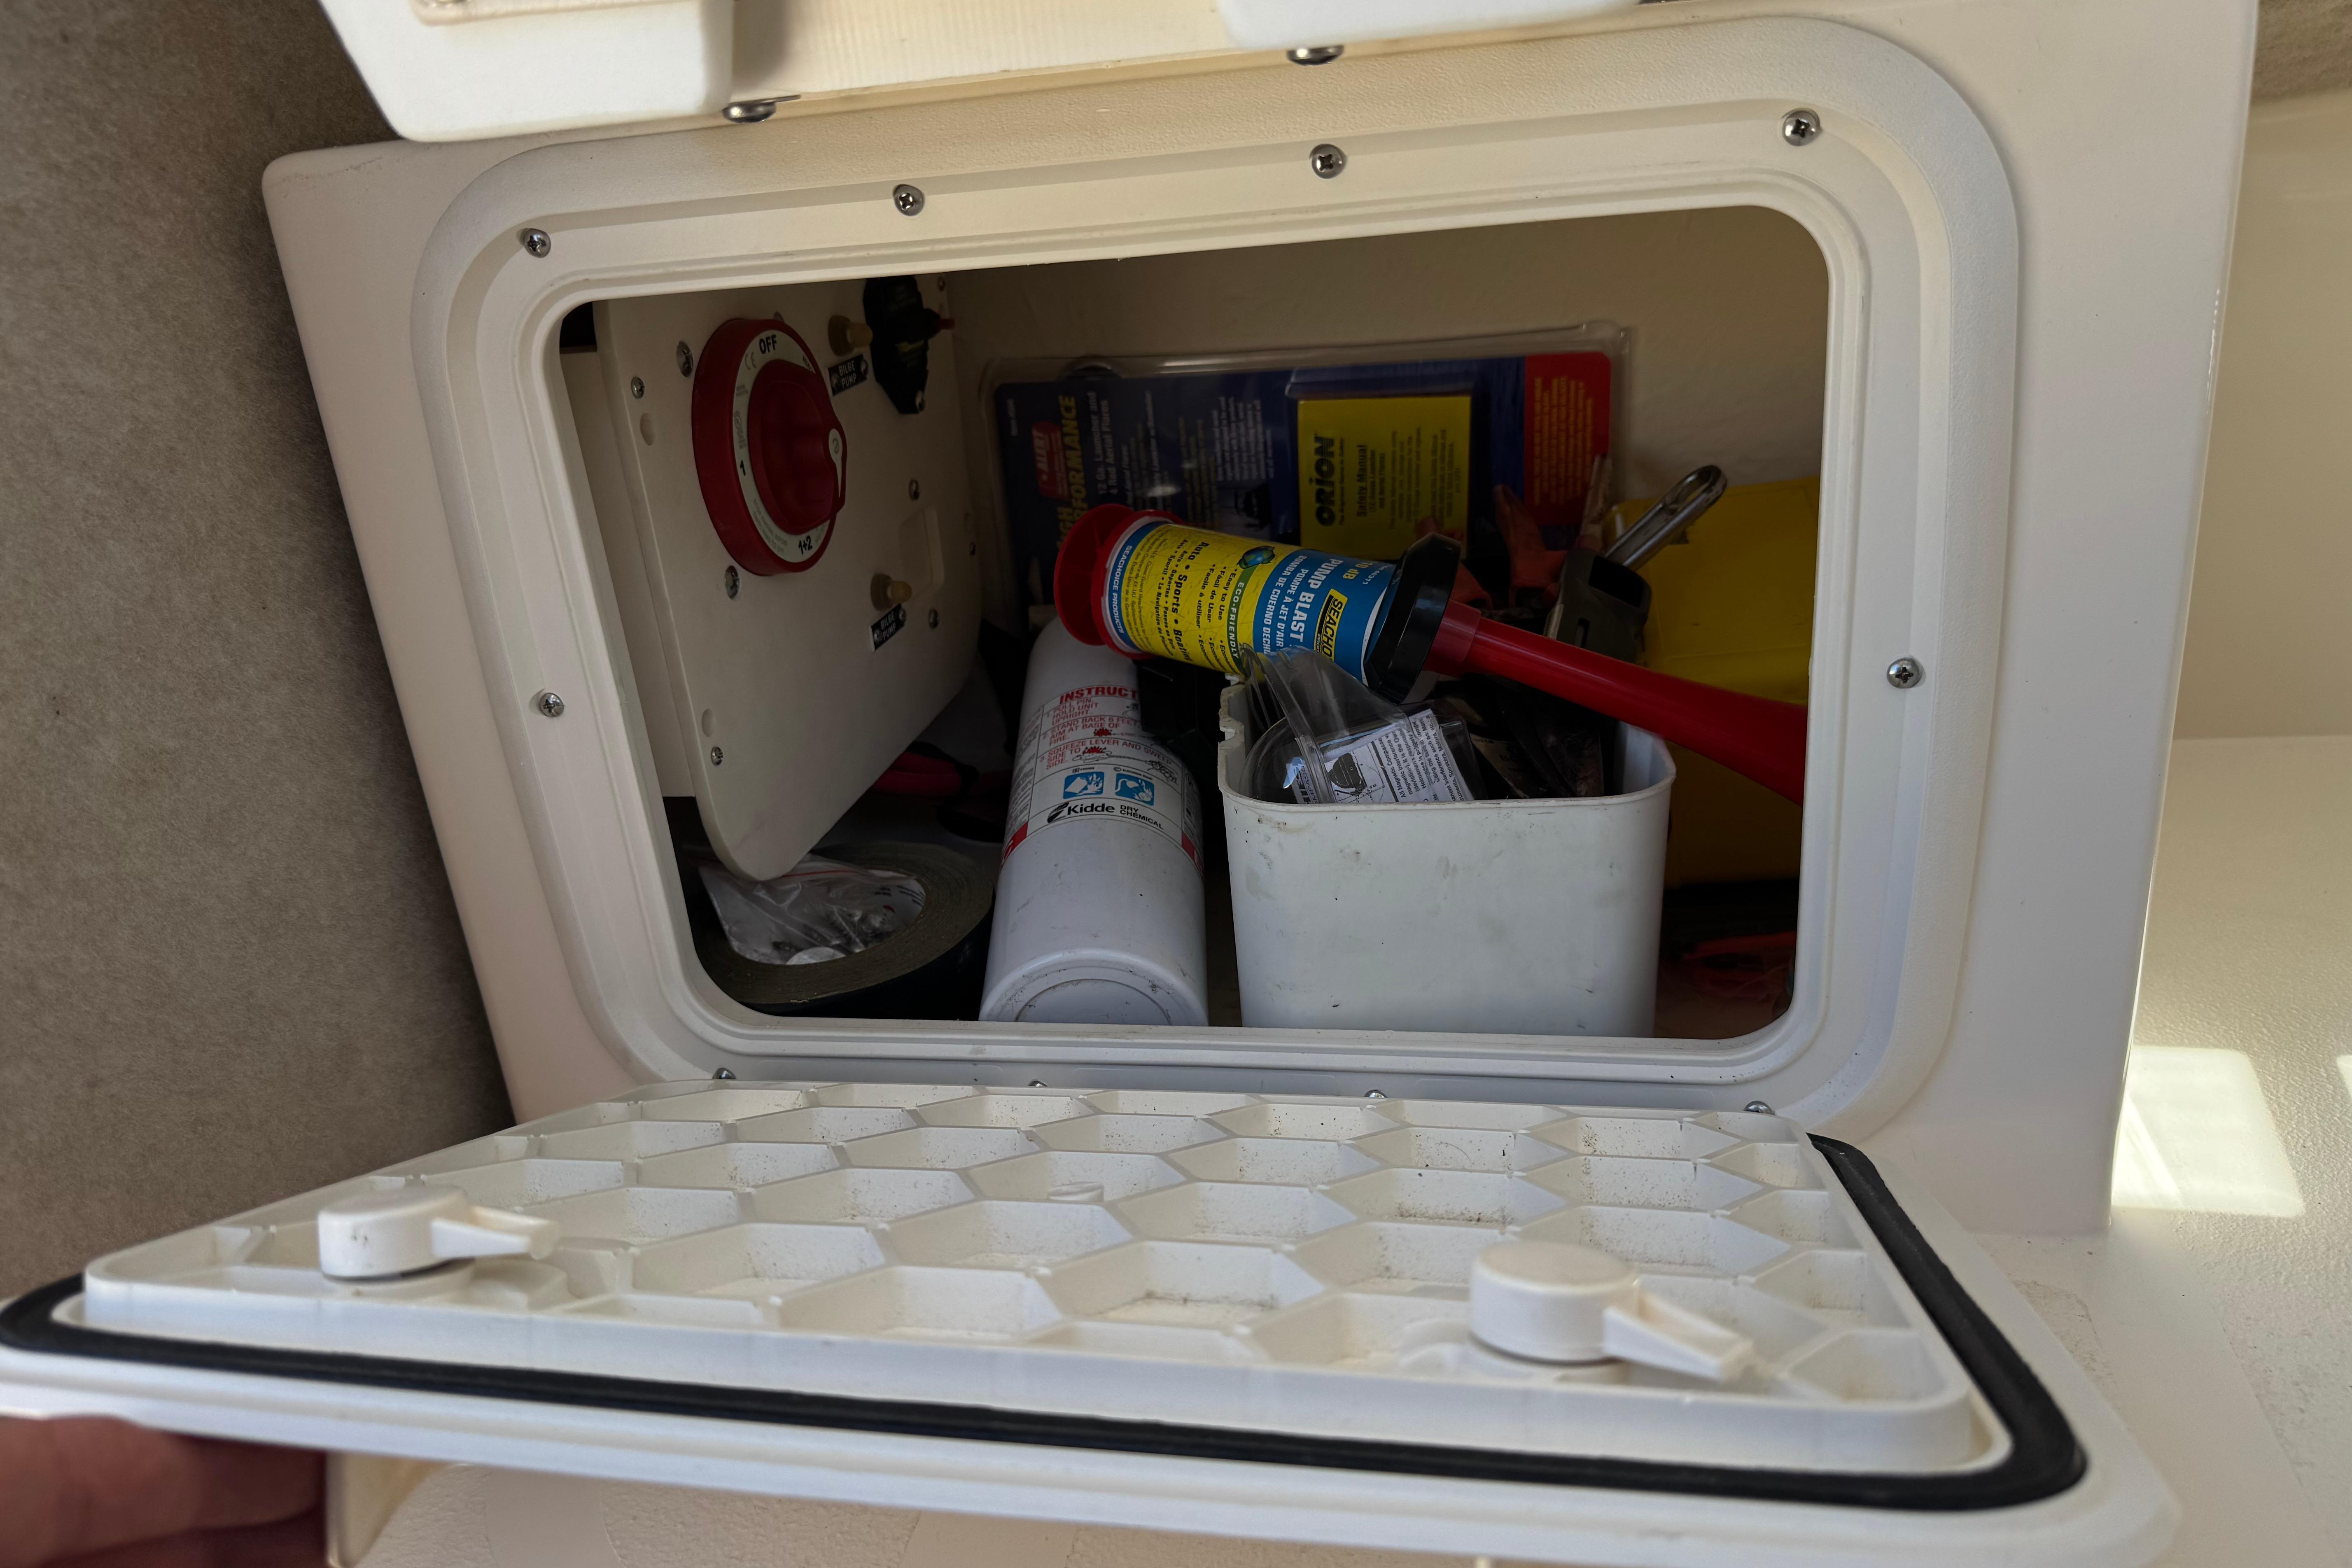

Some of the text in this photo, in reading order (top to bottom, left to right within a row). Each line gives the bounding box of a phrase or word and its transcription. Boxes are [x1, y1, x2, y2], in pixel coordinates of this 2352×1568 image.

[759, 334, 777, 354] OFF
[839, 360, 856, 376] BILGE
[842, 372, 857, 389] PUMP
[740, 461, 746, 476] 1
[1356, 445, 1367, 517] Safety Manual
[798, 535, 813, 554] 1+2
[1188, 542, 1209, 561] Auto
[1162, 555, 1176, 575] Sportif
[1177, 551, 1188, 562] Auto
[1282, 555, 1307, 576] BOMBA
[1165, 570, 1177, 597] Deportes
[1202, 568, 1214, 590] Facile
[1213, 570, 1225, 588] Fácil
[1223, 573, 1236, 590] Easy
[1275, 577, 1287, 587] DE
[1287, 568, 1309, 595] POMPE
[1343, 569, 1359, 580] dB
[1112, 546, 1132, 634] SEACHOICE PRODUCTS
[1172, 574, 1188, 613] Sports
[1210, 590, 1216, 600] de
[1220, 593, 1227, 602] to
[1264, 588, 1281, 625] CUERNO
[1290, 559, 1344, 643] PUMP BLAST
[880, 610, 896, 630] BILGE
[1229, 582, 1245, 659] ECO-FRIENDLY
[1279, 604, 1289, 621] JET
[883, 622, 896, 640] PUMP
[1276, 622, 1285, 647] D'AIR
[1321, 598, 1343, 659] SEACHO
[1060, 686, 1138, 705] INSTRUCT
[1053, 702, 1074, 713] PULL
[1053, 707, 1075, 719] HOLD
[1051, 721, 1079, 733] STAND
[1052, 711, 1089, 726] UPRIGHT
[1050, 730, 1066, 739] AIM
[1048, 741, 1086, 755] SQUEEZE
[1122, 742, 1141, 750] AND
[1144, 747, 1172, 765] SWEEP
[1048, 751, 1066, 761] SIDE
[1377, 738, 1393, 766] Compasse
[1428, 741, 1437, 753] such
[1389, 766, 1404, 790] Magnetic
[1410, 757, 1427, 788] Helmsman's
[1400, 771, 1414, 794] magnetic
[1451, 778, 1465, 801] ruments,
[1447, 785, 1457, 802] anent
[1068, 803, 1115, 815] Kidde
[1120, 810, 1163, 830] CHEMICAL
